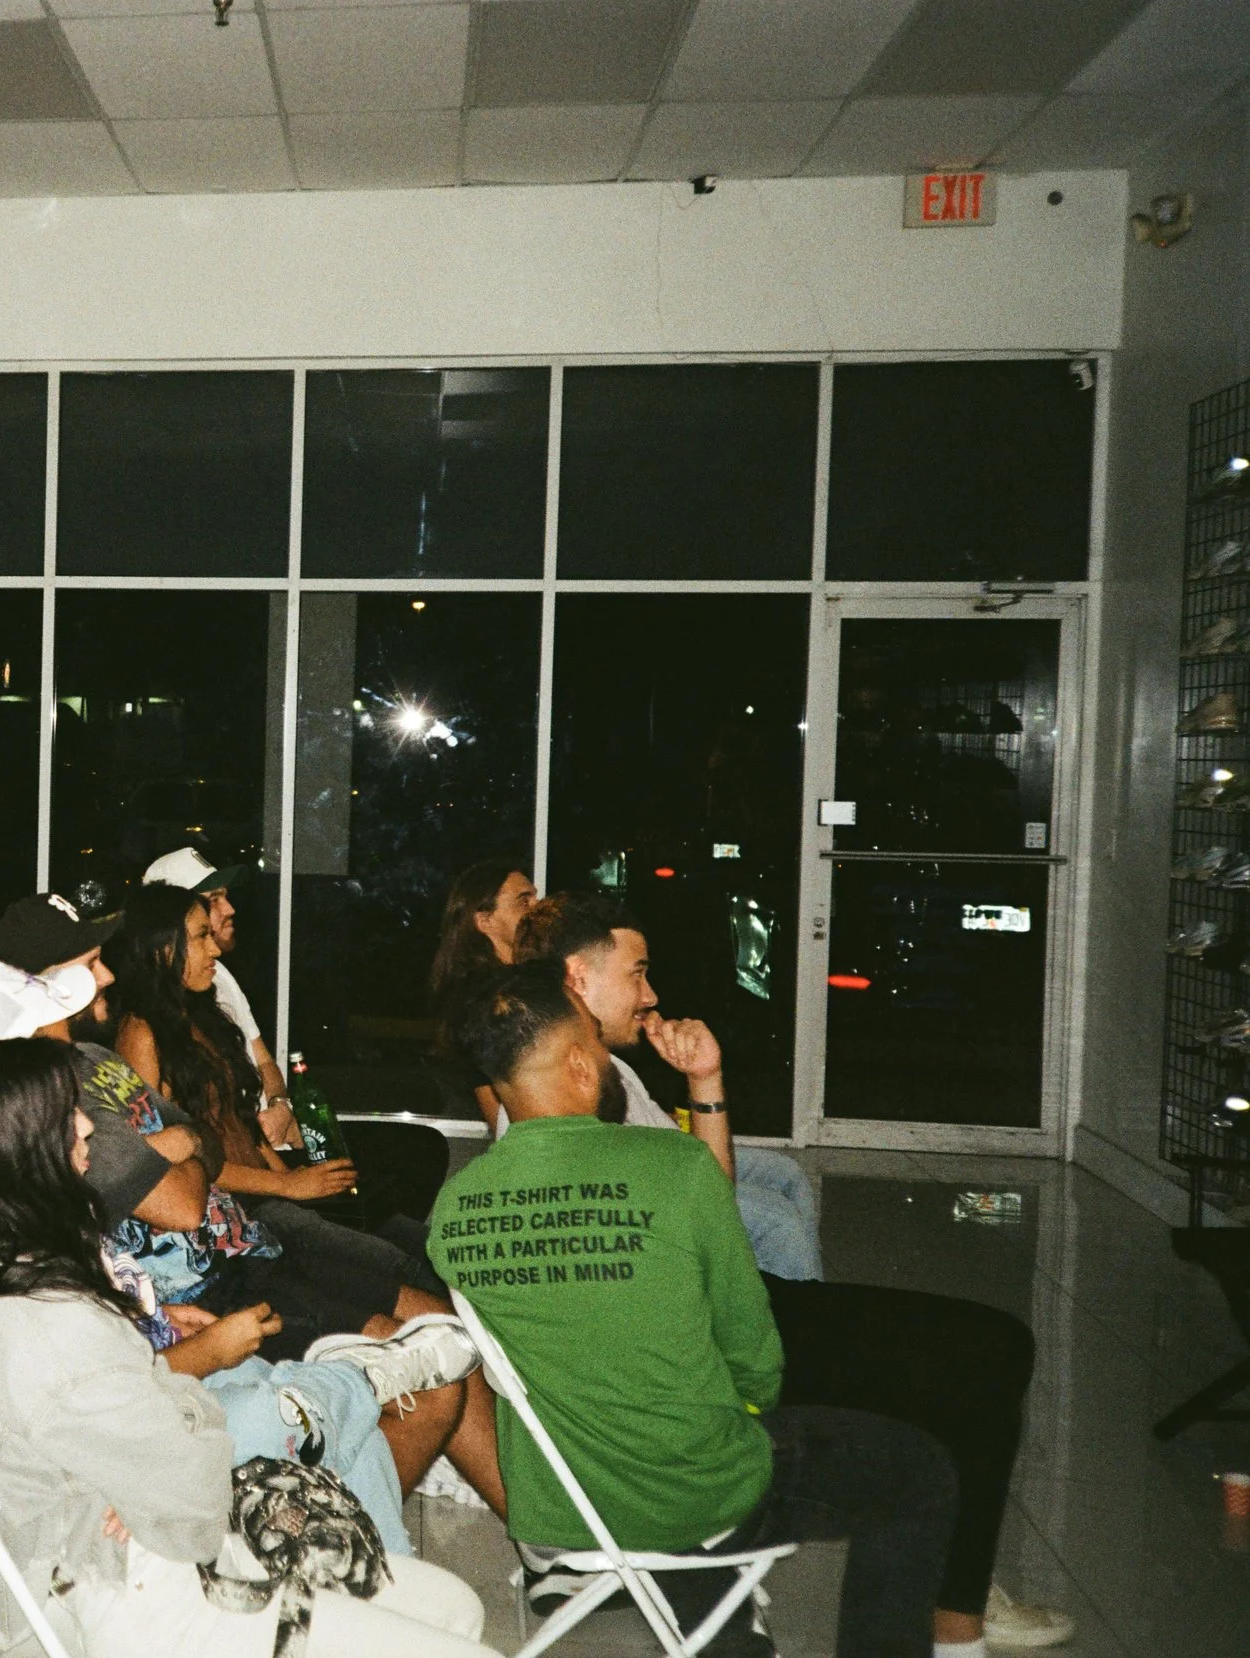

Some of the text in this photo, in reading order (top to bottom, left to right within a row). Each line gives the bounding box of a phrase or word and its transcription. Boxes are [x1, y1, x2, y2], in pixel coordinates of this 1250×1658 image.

[922, 174, 985, 220] EXIT
[458, 1183, 629, 1211] THIS T-SHIRT WAS
[441, 1209, 654, 1240] SELECTED CAREFULLY
[447, 1233, 645, 1264] WITH A PARTICULAR
[457, 1262, 634, 1288] PURPOSE IN MIND
